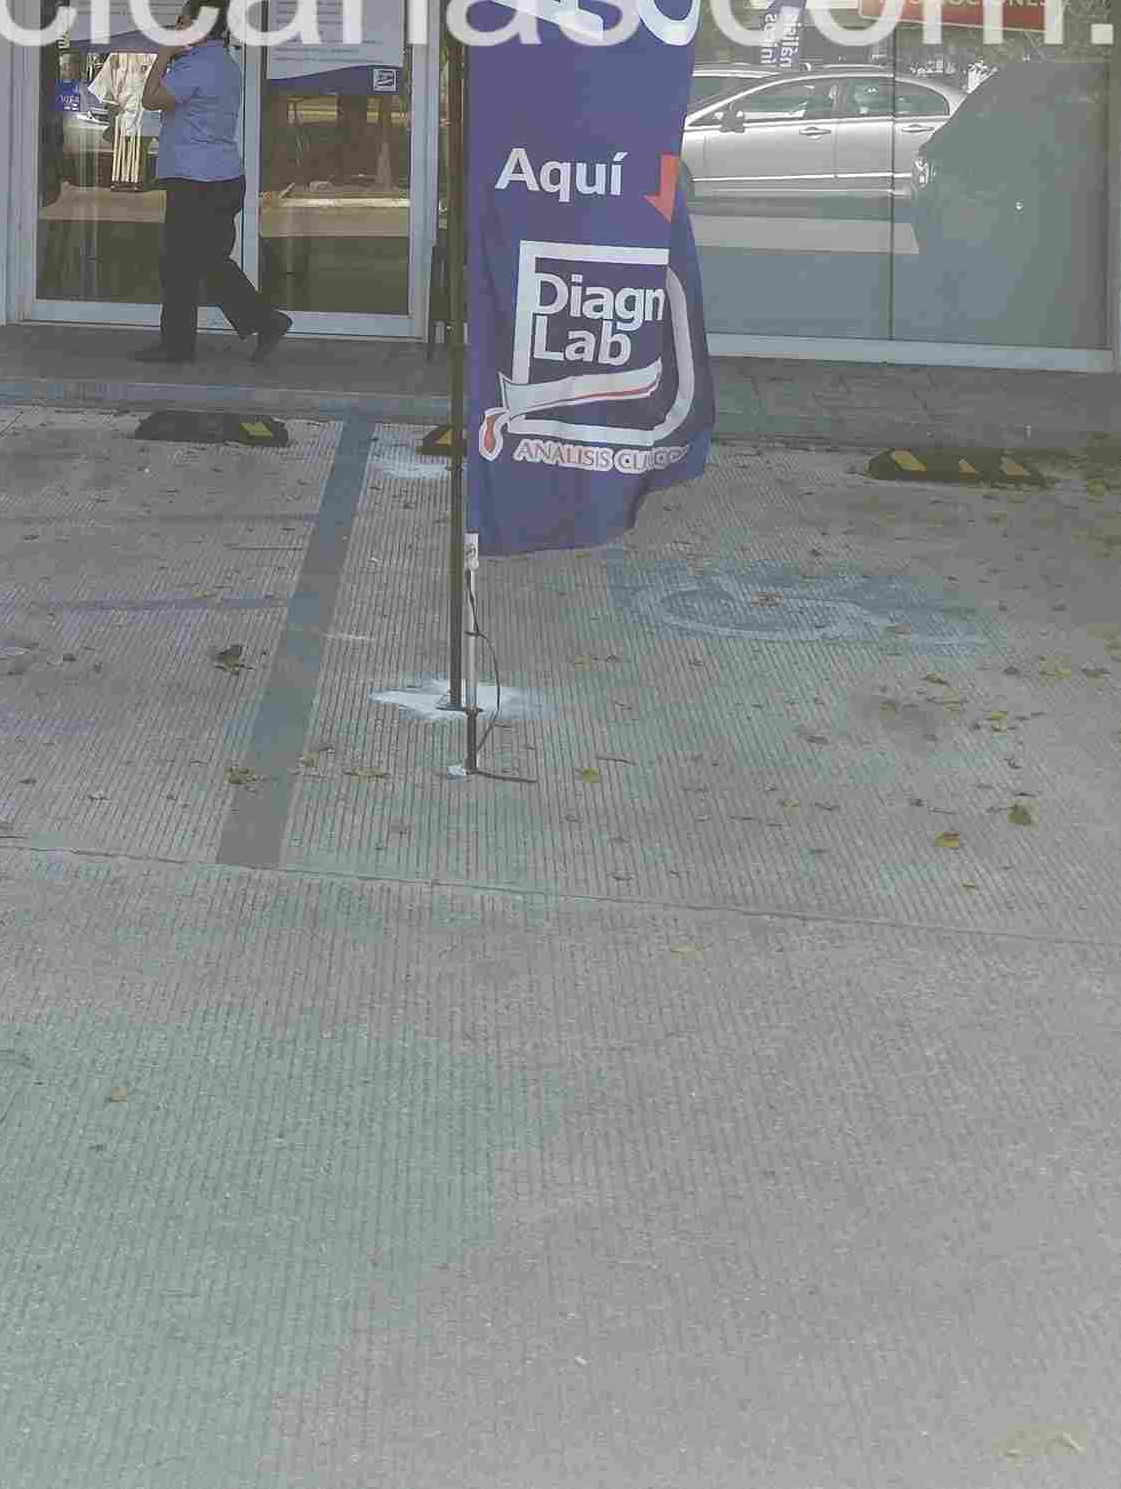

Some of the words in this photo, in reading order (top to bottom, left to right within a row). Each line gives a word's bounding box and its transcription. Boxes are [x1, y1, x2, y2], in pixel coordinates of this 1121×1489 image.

[494, 148, 627, 202] Aquí
[533, 315, 632, 366] Lab
[513, 438, 614, 472] ANALISIS
